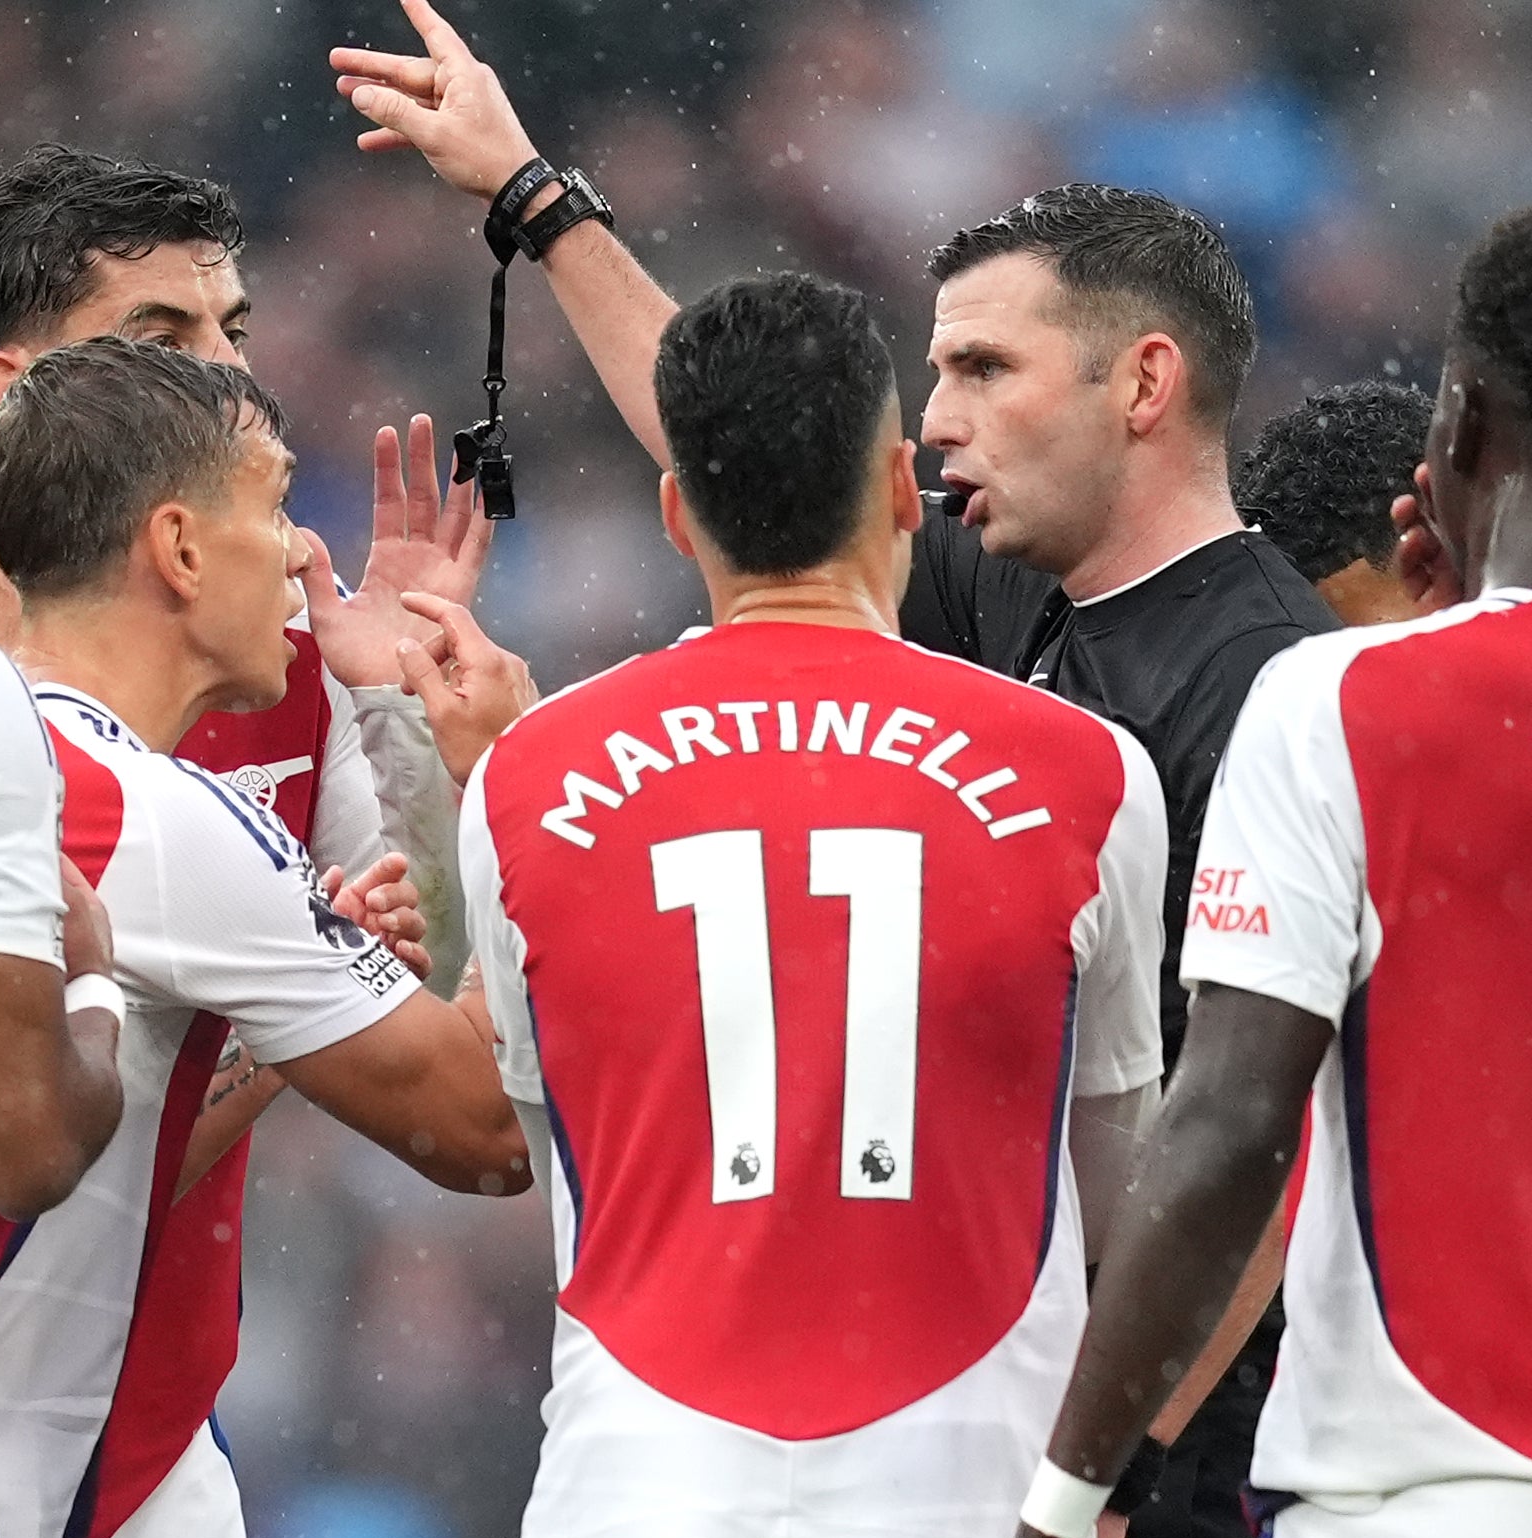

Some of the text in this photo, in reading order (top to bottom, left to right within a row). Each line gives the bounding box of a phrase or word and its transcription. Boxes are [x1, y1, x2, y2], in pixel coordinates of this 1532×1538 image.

[539, 699, 1053, 850] MARTINELLI
[348, 958, 379, 985] No
[648, 826, 924, 1205] 11
